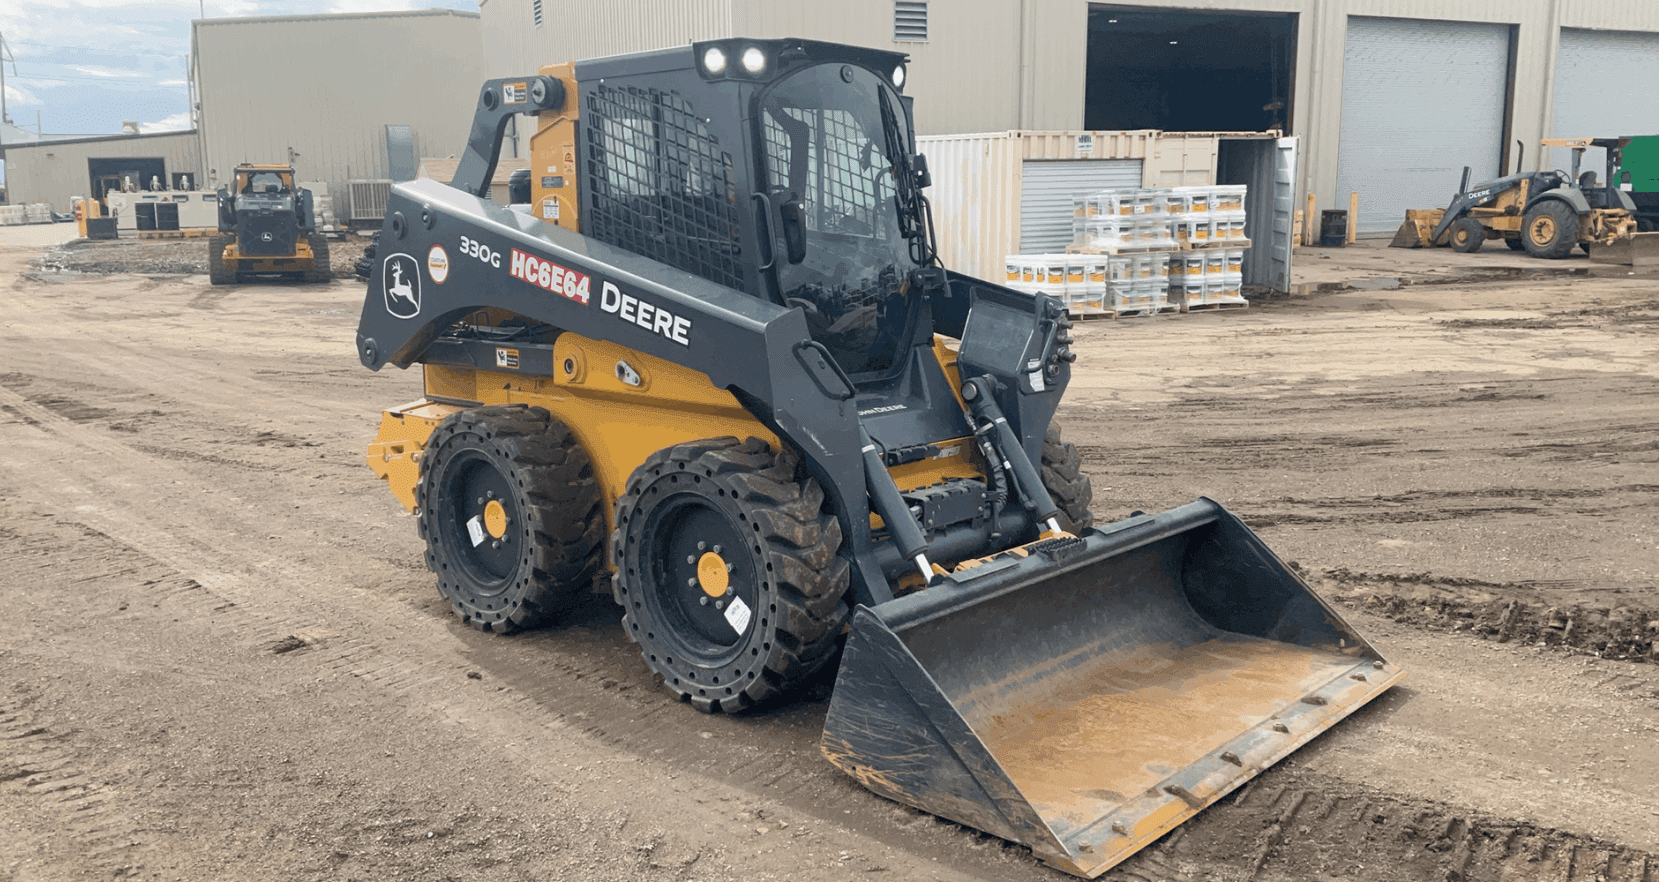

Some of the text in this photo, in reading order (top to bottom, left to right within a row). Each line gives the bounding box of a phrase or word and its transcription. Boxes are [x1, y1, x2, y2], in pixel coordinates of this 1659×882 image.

[1468, 190, 1490, 199] DEERE
[460, 236, 501, 268] 330G
[511, 250, 590, 304] HC6E64
[600, 280, 692, 346] DEERE
[873, 404, 907, 412] DEERE
